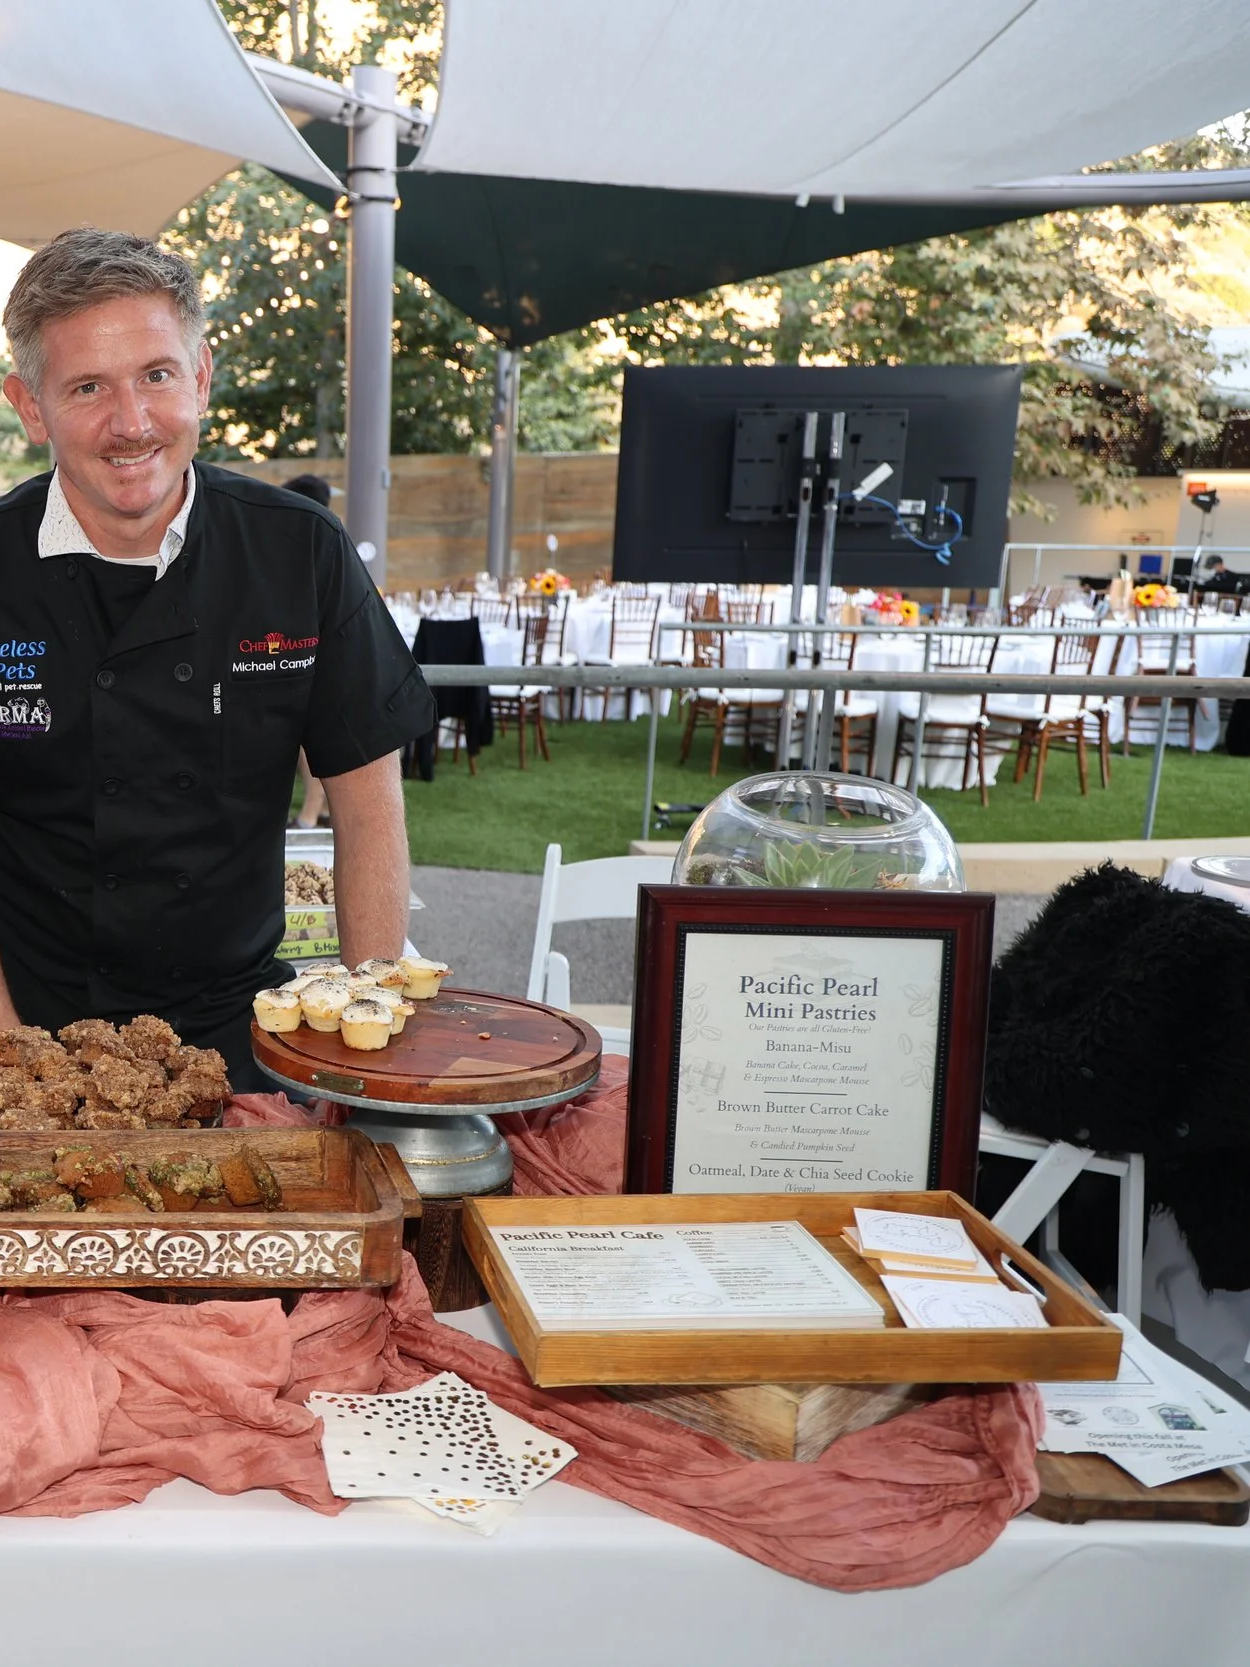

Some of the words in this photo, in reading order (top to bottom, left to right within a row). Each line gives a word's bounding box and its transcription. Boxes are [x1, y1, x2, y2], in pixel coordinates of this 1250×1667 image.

[232, 660, 276, 672] Michael
[213, 682, 221, 696] ROLL
[738, 974, 814, 995] Pacific
[822, 977, 879, 997] Pearl
[744, 1002, 794, 1019] Mini
[801, 1003, 877, 1021] Pastries
[748, 1023, 764, 1031] Our
[766, 1024, 795, 1032] Pastries
[810, 1024, 820, 1033] all
[766, 1039, 852, 1054] Banana-Misu
[746, 1060, 775, 1069] Banana
[778, 1061, 801, 1070] Cake,
[803, 1062, 830, 1071] Cocoa,
[832, 1062, 868, 1072] Caramel
[754, 1073, 788, 1085] Espresso
[790, 1074, 837, 1086] Mascarpone
[839, 1076, 870, 1085] Mousse
[717, 1100, 761, 1113] Brown
[766, 1101, 806, 1115] Butter
[809, 1102, 852, 1116] Carrot
[856, 1104, 890, 1117] Cake
[734, 1123, 761, 1132] Brown
[763, 1124, 789, 1133] Butter
[791, 1124, 838, 1137] Mascarpone
[840, 1126, 871, 1136] Mousse
[761, 1141, 795, 1150] Candied
[797, 1142, 834, 1153] Pumpkin
[835, 1143, 855, 1152] Seed
[750, 1165, 780, 1178] Date
[783, 1167, 794, 1178] &
[799, 1166, 830, 1180] Chia
[833, 1168, 863, 1181] Seed
[867, 1169, 914, 1183] Cookie
[500, 1231, 562, 1242] Pacific
[566, 1230, 616, 1240] Pearl
[620, 1230, 664, 1241] Cafe
[1088, 1432, 1132, 1440] Opening
